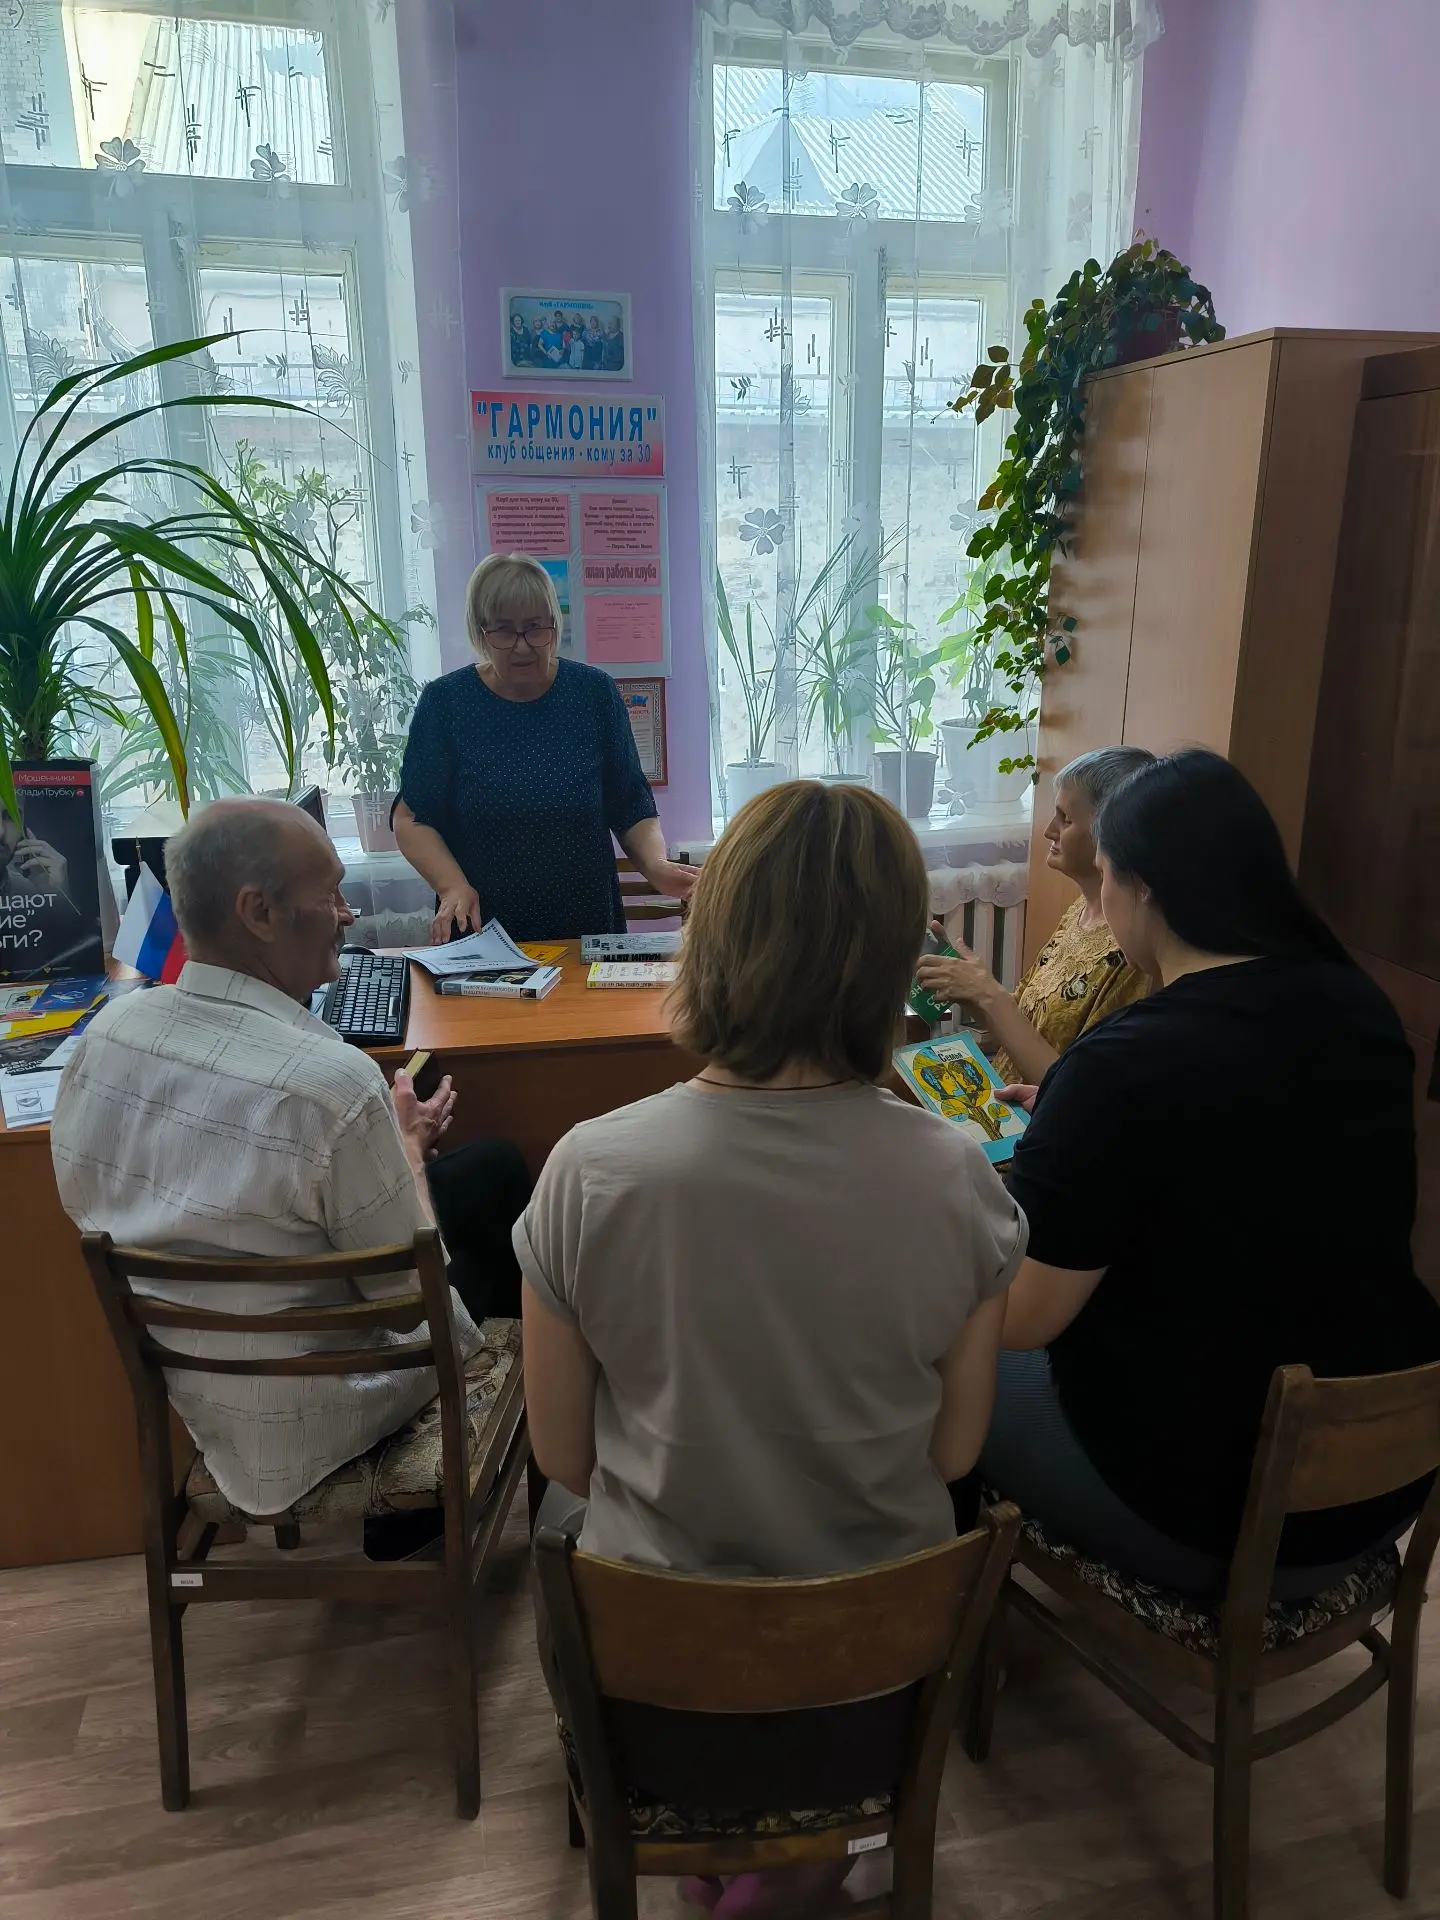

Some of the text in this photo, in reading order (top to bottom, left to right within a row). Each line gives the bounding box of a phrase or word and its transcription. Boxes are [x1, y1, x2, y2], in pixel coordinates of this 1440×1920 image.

[476, 401, 657, 442] "ГАРМОНИЯ"
[487, 440, 516, 464] клуб
[521, 440, 575, 465] общения
[587, 447, 615, 466] кому
[620, 449, 633, 462] за
[637, 445, 651, 463] 30
[585, 562, 656, 582] план работы клуба
[18, 774, 75, 783] Мошенники
